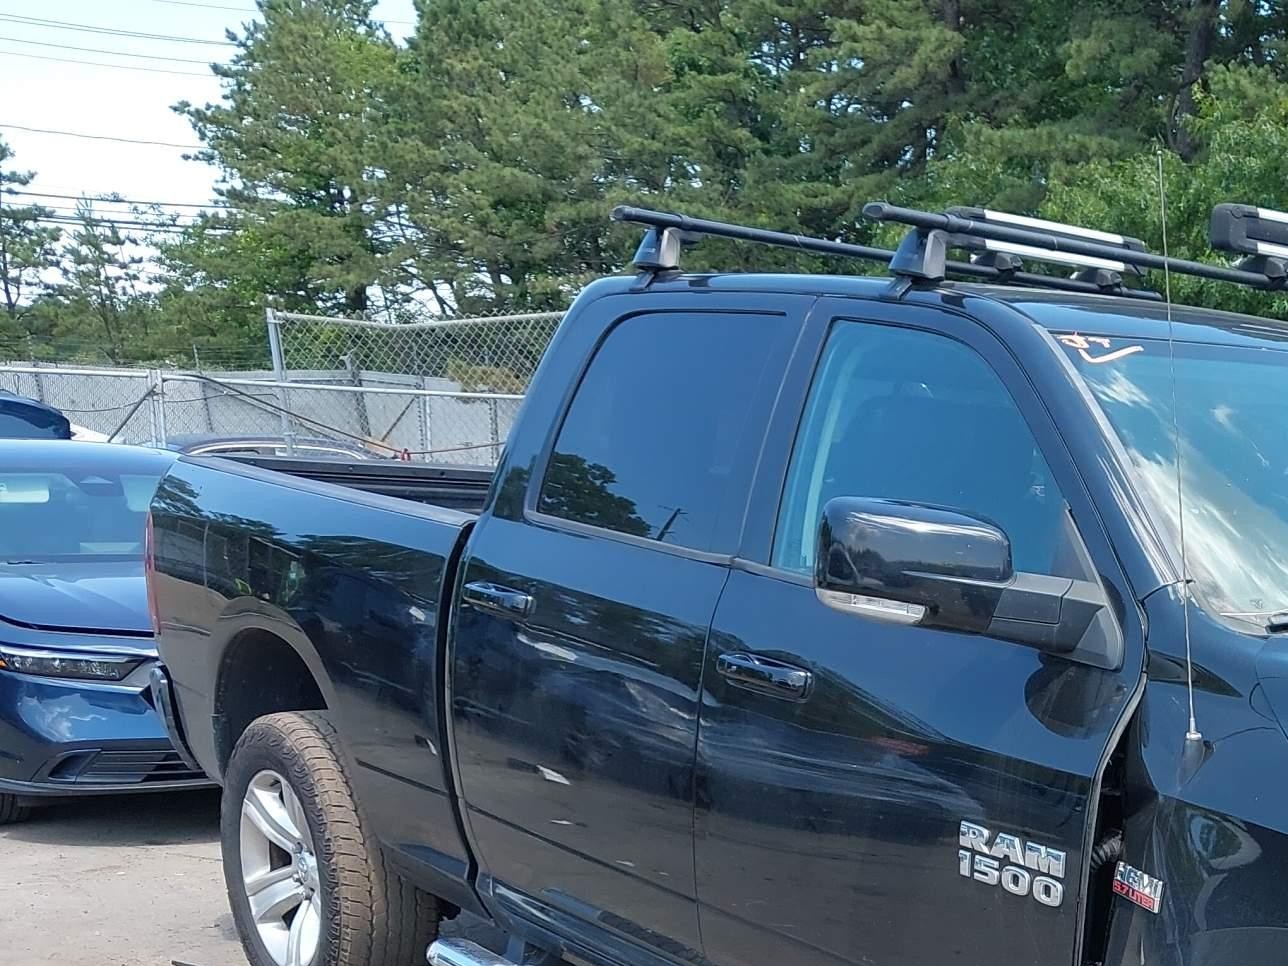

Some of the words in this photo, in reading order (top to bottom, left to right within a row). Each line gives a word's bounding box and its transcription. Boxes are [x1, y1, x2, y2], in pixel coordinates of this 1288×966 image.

[959, 820, 1067, 879] RAM
[958, 849, 1063, 908] 1500
[1114, 881, 1129, 895] 5.7
[1128, 888, 1154, 910] LITER
[1116, 861, 1162, 898] HEMI
